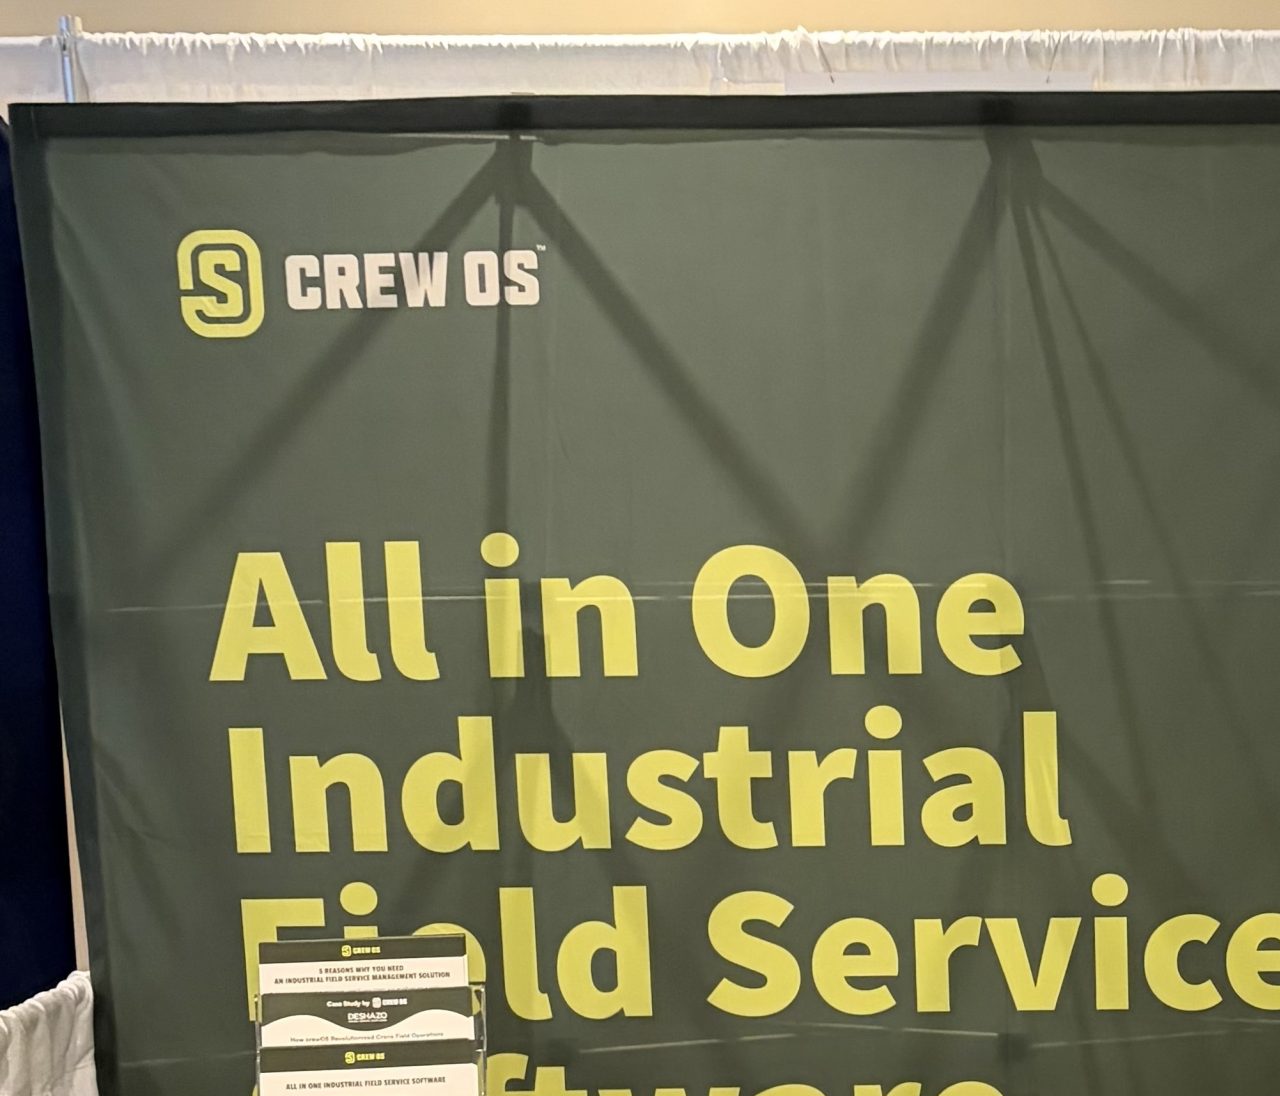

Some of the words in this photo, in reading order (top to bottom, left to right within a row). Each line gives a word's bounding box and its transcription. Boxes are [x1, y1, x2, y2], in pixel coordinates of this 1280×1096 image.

[285, 252, 448, 311] CREW
[209, 540, 440, 682] All
[480, 532, 639, 678] in
[692, 544, 1024, 678] One
[228, 705, 1073, 853] Industrial
[285, 976, 324, 984] INDUSTRIAL
[326, 975, 343, 983] FIELD
[344, 974, 370, 982] SERVICE
[372, 973, 417, 981] MANAGEMENT
[419, 971, 450, 979] SOLUTION
[347, 1012, 388, 1020] DESHAZO
[323, 1080, 363, 1088] INDUSTRIAL
[364, 1079, 382, 1087] FIELD
[384, 1078, 410, 1086] SERVICE
[412, 1076, 446, 1084] SOFTWARE
